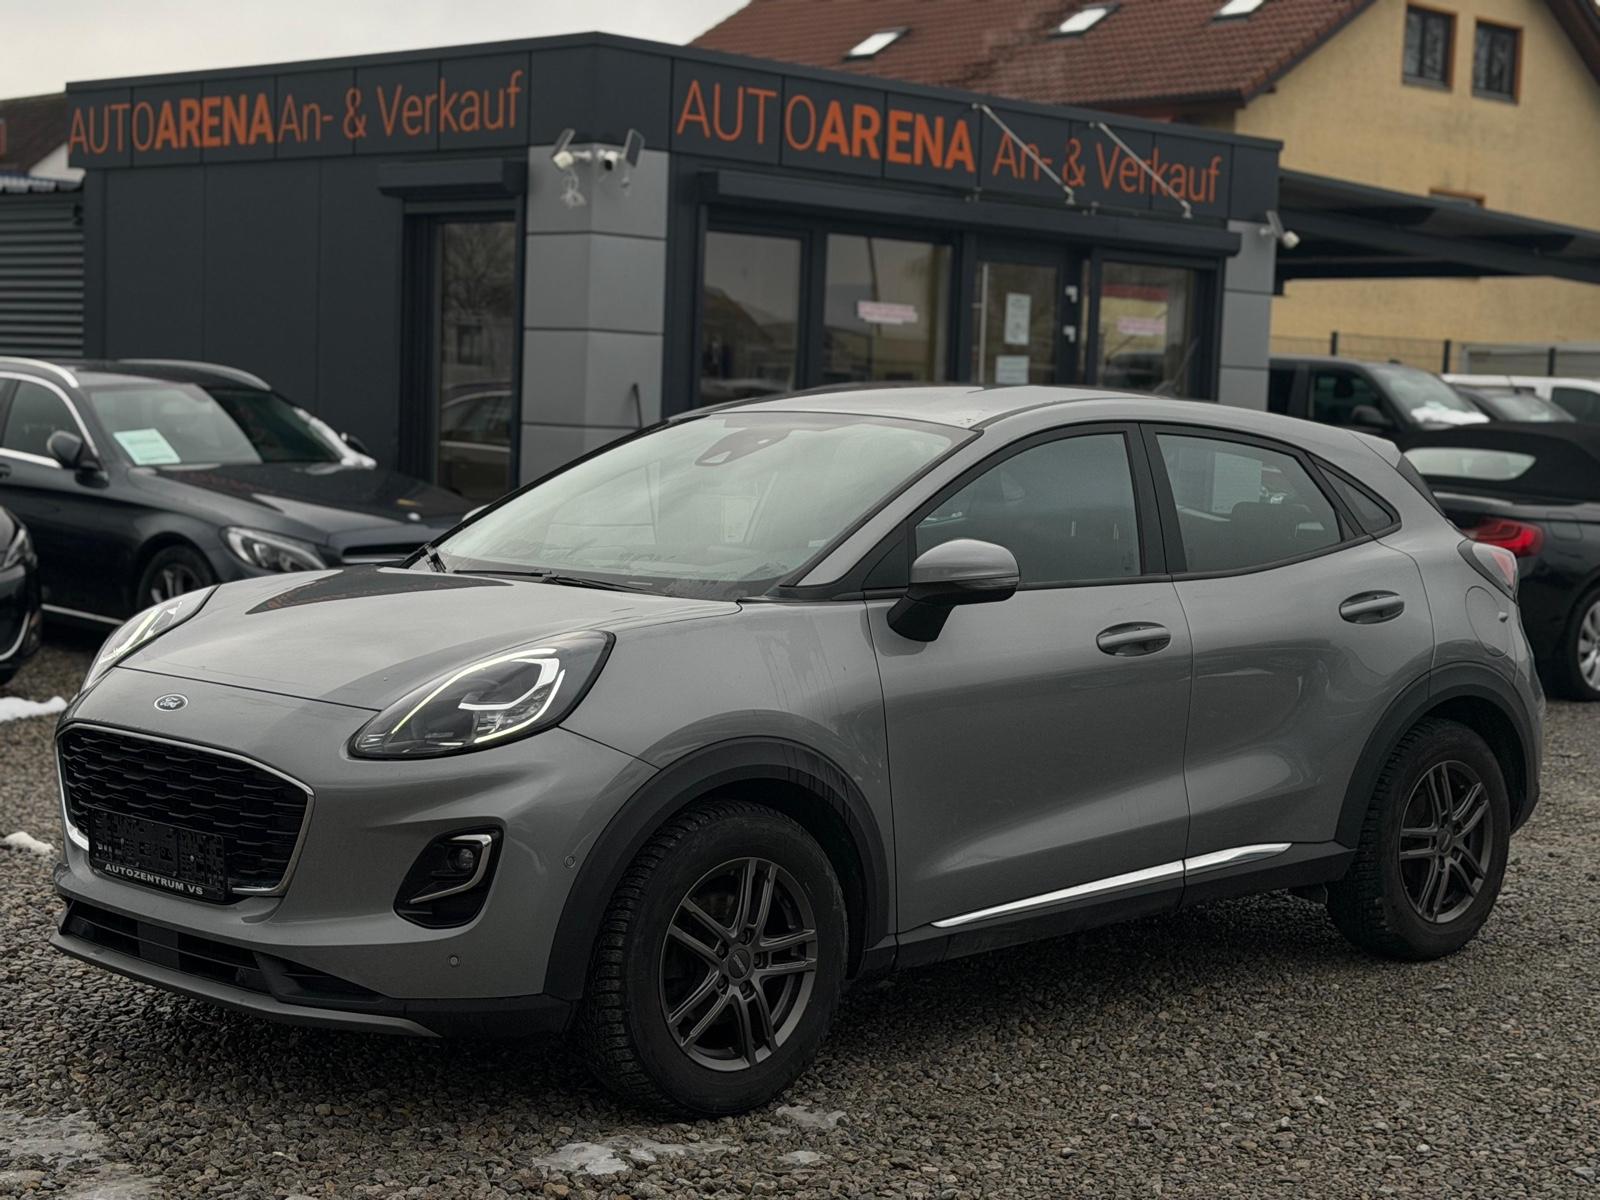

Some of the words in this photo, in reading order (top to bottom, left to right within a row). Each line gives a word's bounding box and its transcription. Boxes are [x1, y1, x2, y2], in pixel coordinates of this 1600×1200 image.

[68, 93, 275, 155] AUTOARENA
[277, 94, 334, 142] An-
[342, 87, 368, 139] &
[376, 69, 523, 137] Verkauf
[676, 79, 976, 173] AUTOARENA
[991, 131, 1053, 182] An-
[1062, 138, 1086, 187] &
[1096, 143, 1222, 204] Verkauf
[104, 863, 185, 891] AUTOZENTRUM
[187, 884, 204, 895] VS
